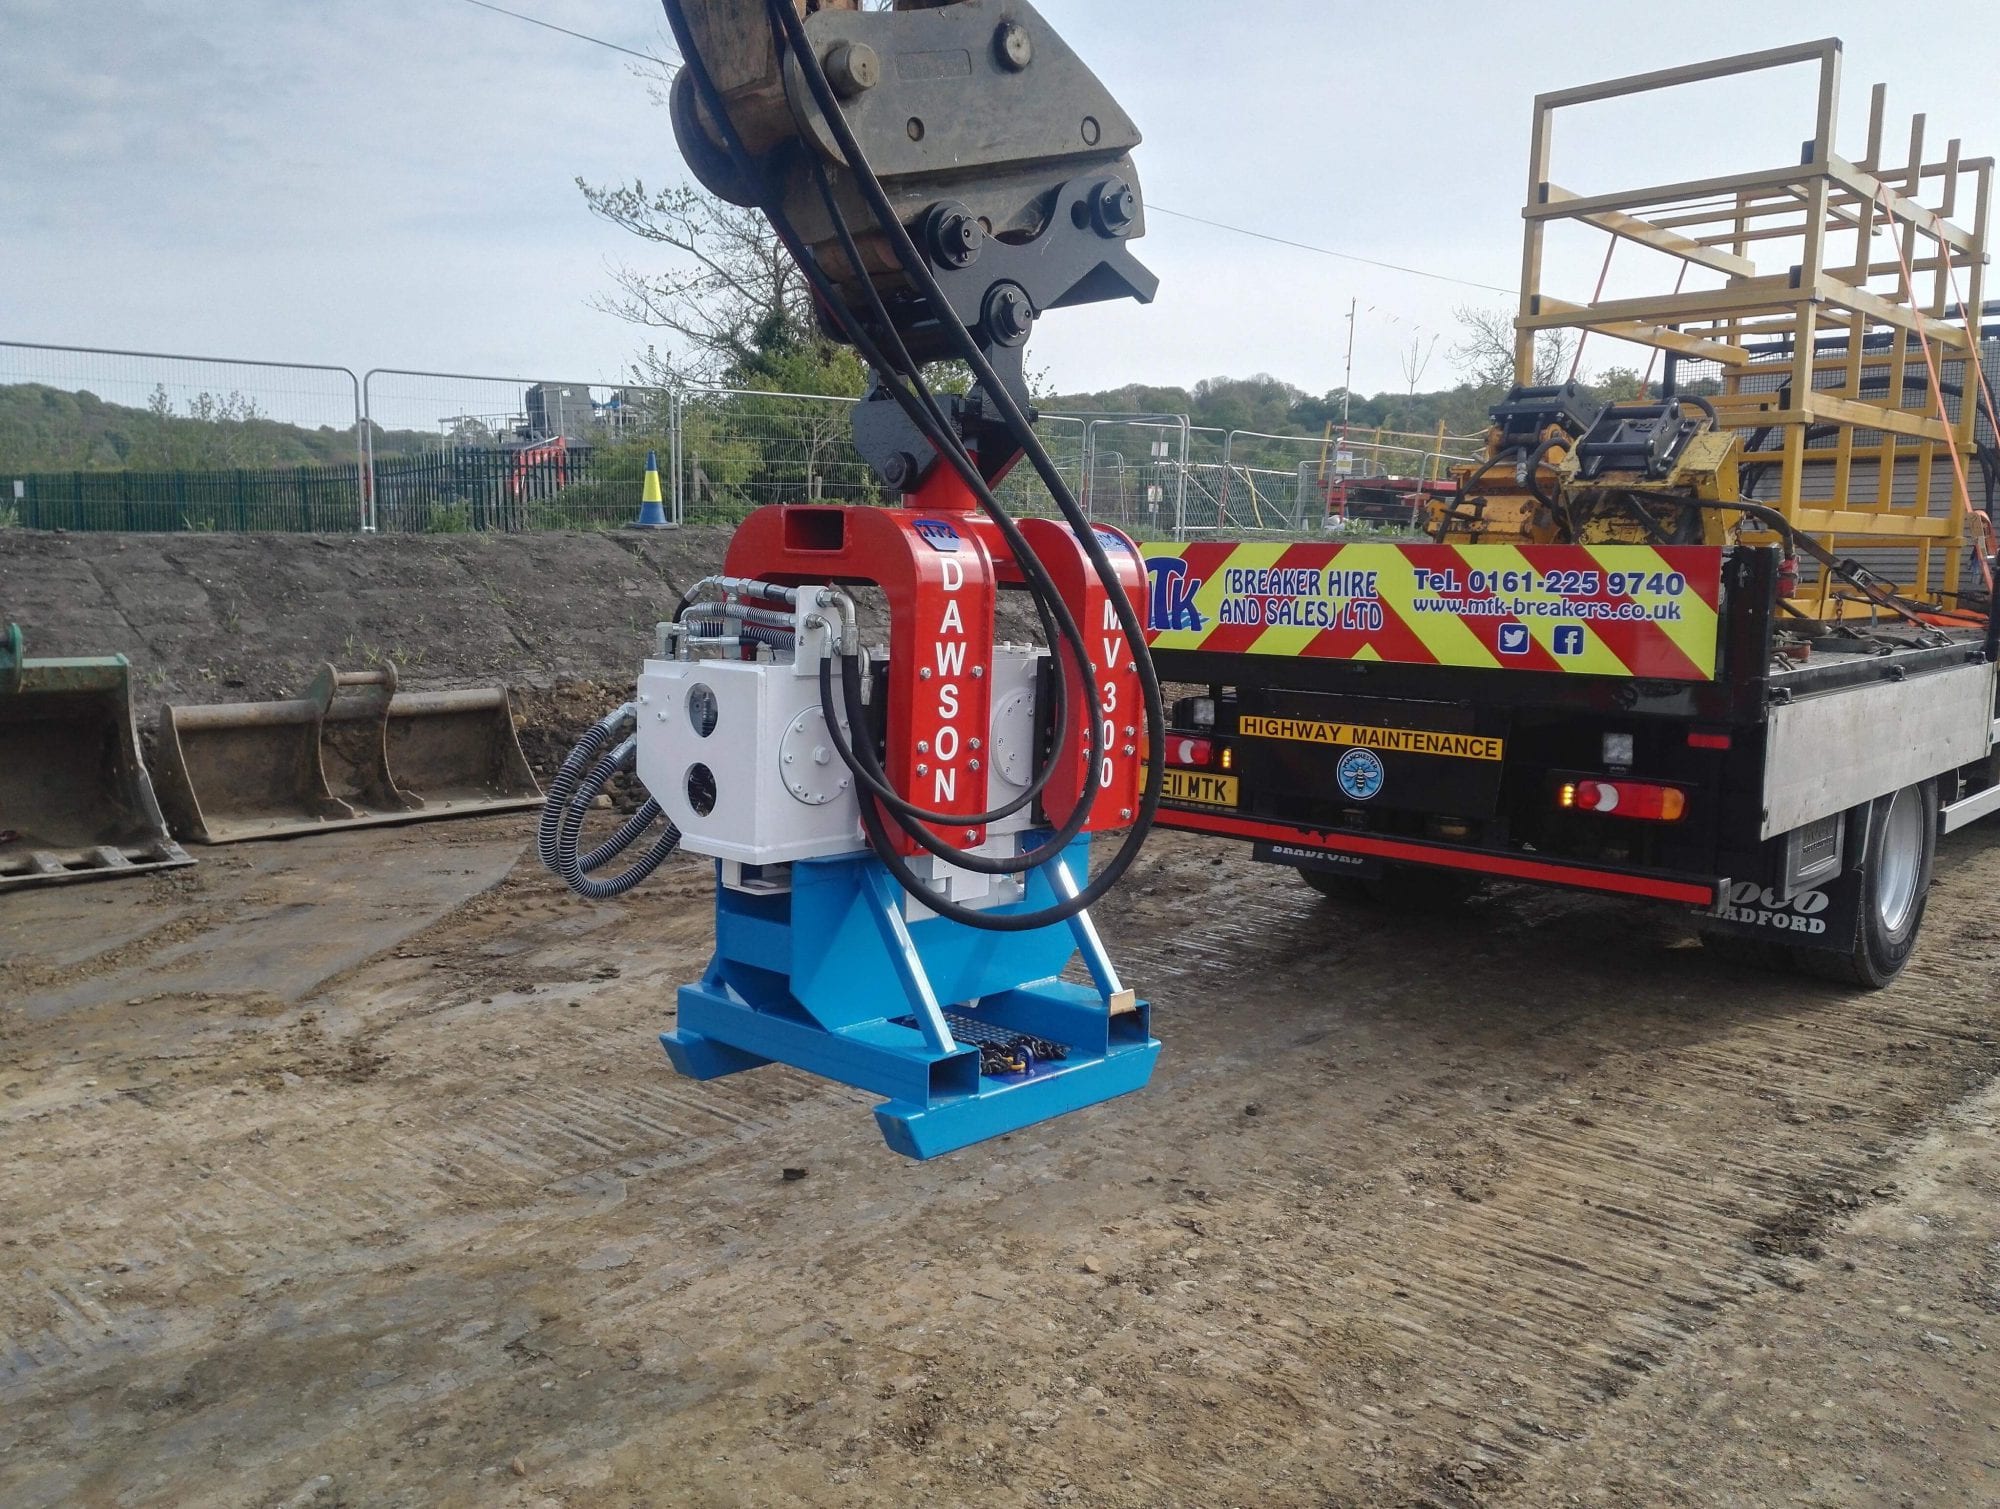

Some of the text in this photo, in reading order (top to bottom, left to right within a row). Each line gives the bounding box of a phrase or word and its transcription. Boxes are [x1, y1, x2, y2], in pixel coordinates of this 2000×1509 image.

[1224, 568, 1378, 599] (BREAKER HIRE
[1413, 568, 1686, 598] Tel. 0161-225 9740
[1219, 598, 1383, 631] AND SALES) LTD
[1413, 597, 1682, 621] www.mtk-breakers.co.uk
[934, 557, 967, 803] DAWSON
[1100, 681, 1117, 788] 300
[1243, 717, 1498, 758] HIGHWAY MAINTENANCE
[1342, 752, 1378, 769] MANCHESTER
[1187, 775, 1227, 802] MTK
[1691, 906, 1827, 935] ADFORD
